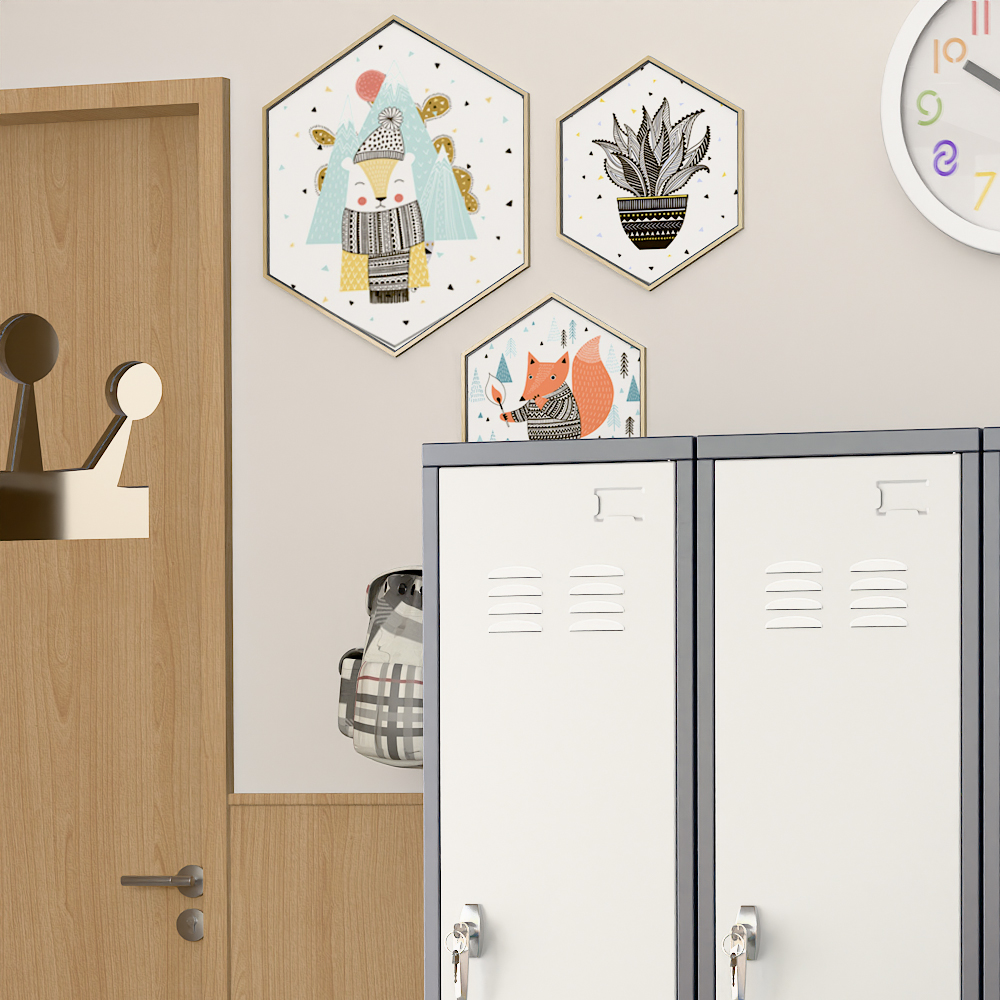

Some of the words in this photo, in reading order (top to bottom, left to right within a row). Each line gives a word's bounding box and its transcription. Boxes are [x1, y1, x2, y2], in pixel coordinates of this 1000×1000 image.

[971, 0, 990, 35] 11
[933, 37, 967, 74] 10
[916, 90, 943, 126] 9
[933, 139, 958, 177] 8
[974, 171, 997, 211] 7
